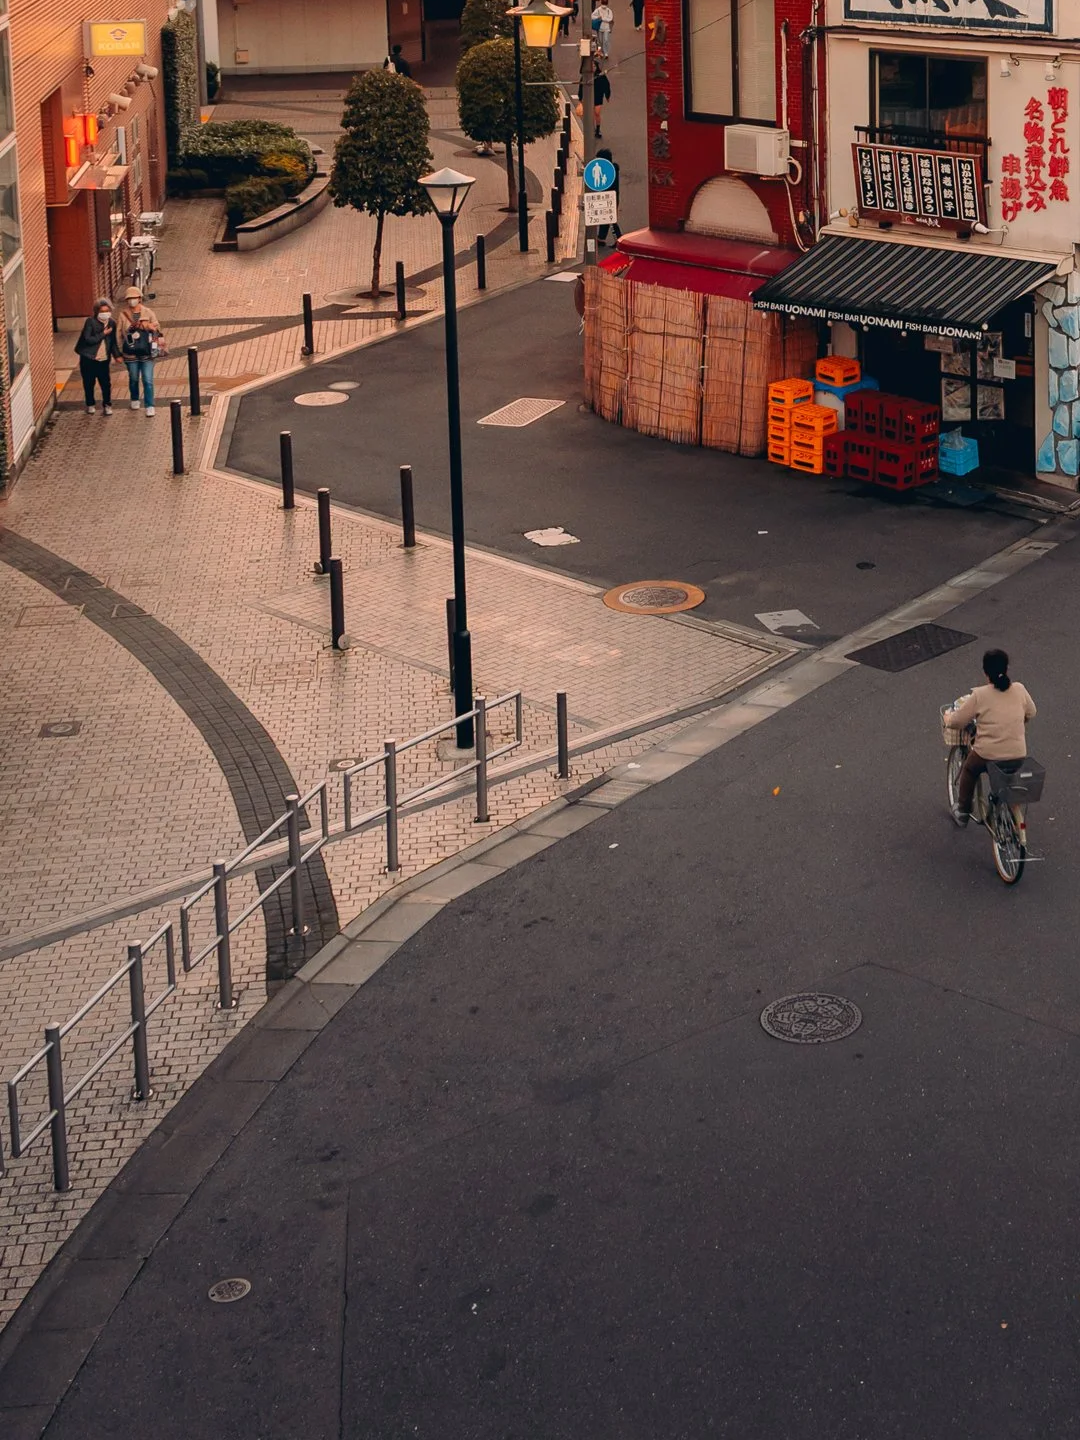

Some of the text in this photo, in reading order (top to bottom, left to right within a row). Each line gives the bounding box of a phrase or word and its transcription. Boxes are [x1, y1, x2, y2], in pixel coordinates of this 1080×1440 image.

[1000, 153, 1023, 223] 串揚げ
[1023, 96, 1047, 213] 名物煮込み
[1047, 86, 1070, 203] 朝どれ鮮魚
[770, 302, 784, 311] BAR
[784, 305, 826, 318] UONAMI
[828, 311, 844, 320] FISH
[844, 313, 859, 322] BAR
[859, 314, 903, 329] UONAMI
[905, 322, 922, 331] FISH
[922, 324, 938, 333] BAR
